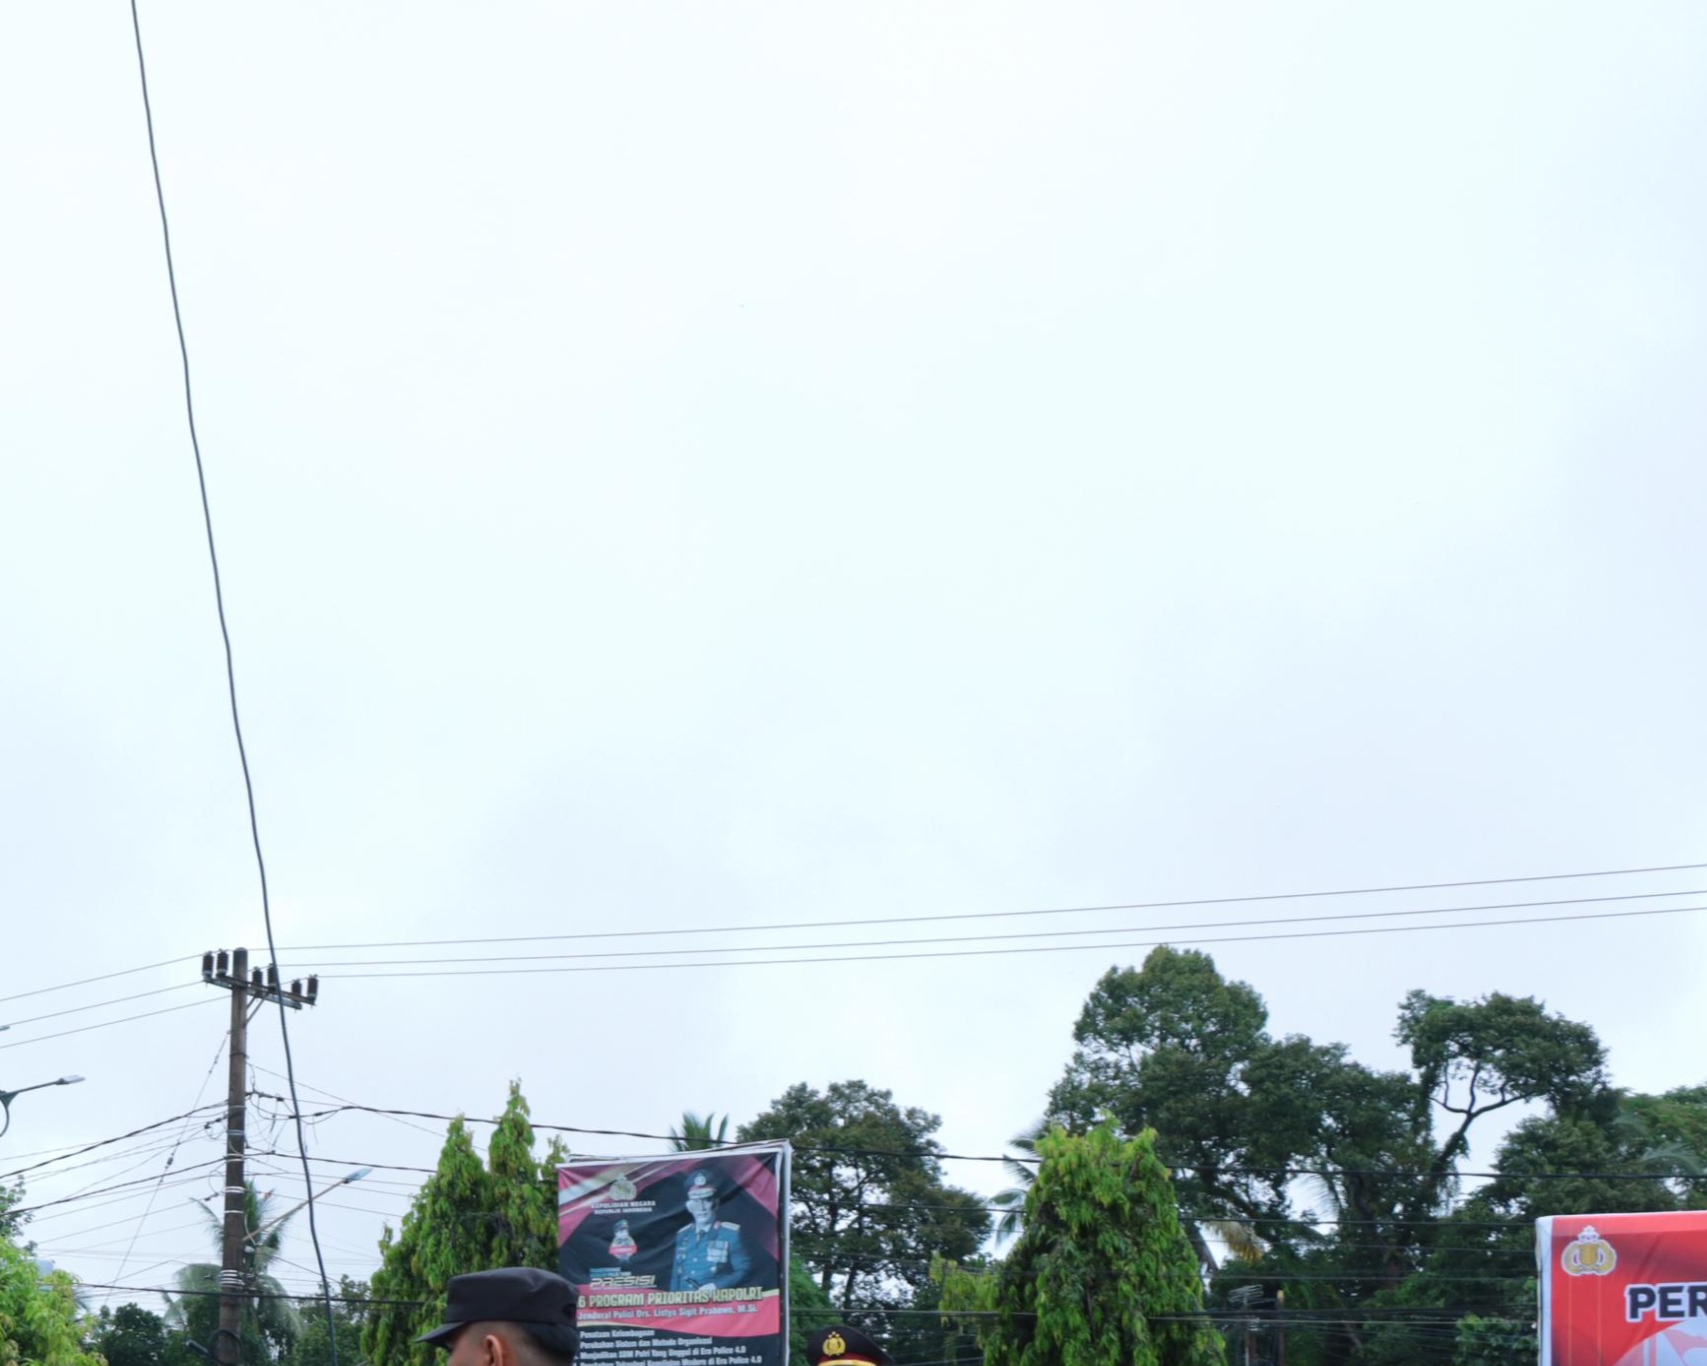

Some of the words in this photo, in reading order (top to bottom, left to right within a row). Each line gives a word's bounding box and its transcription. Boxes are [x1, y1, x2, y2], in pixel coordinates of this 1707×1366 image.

[588, 1292, 645, 1309] PROGRAM
[648, 1289, 710, 1306] PRIORITAS
[712, 1286, 763, 1302] KAPOLRI
